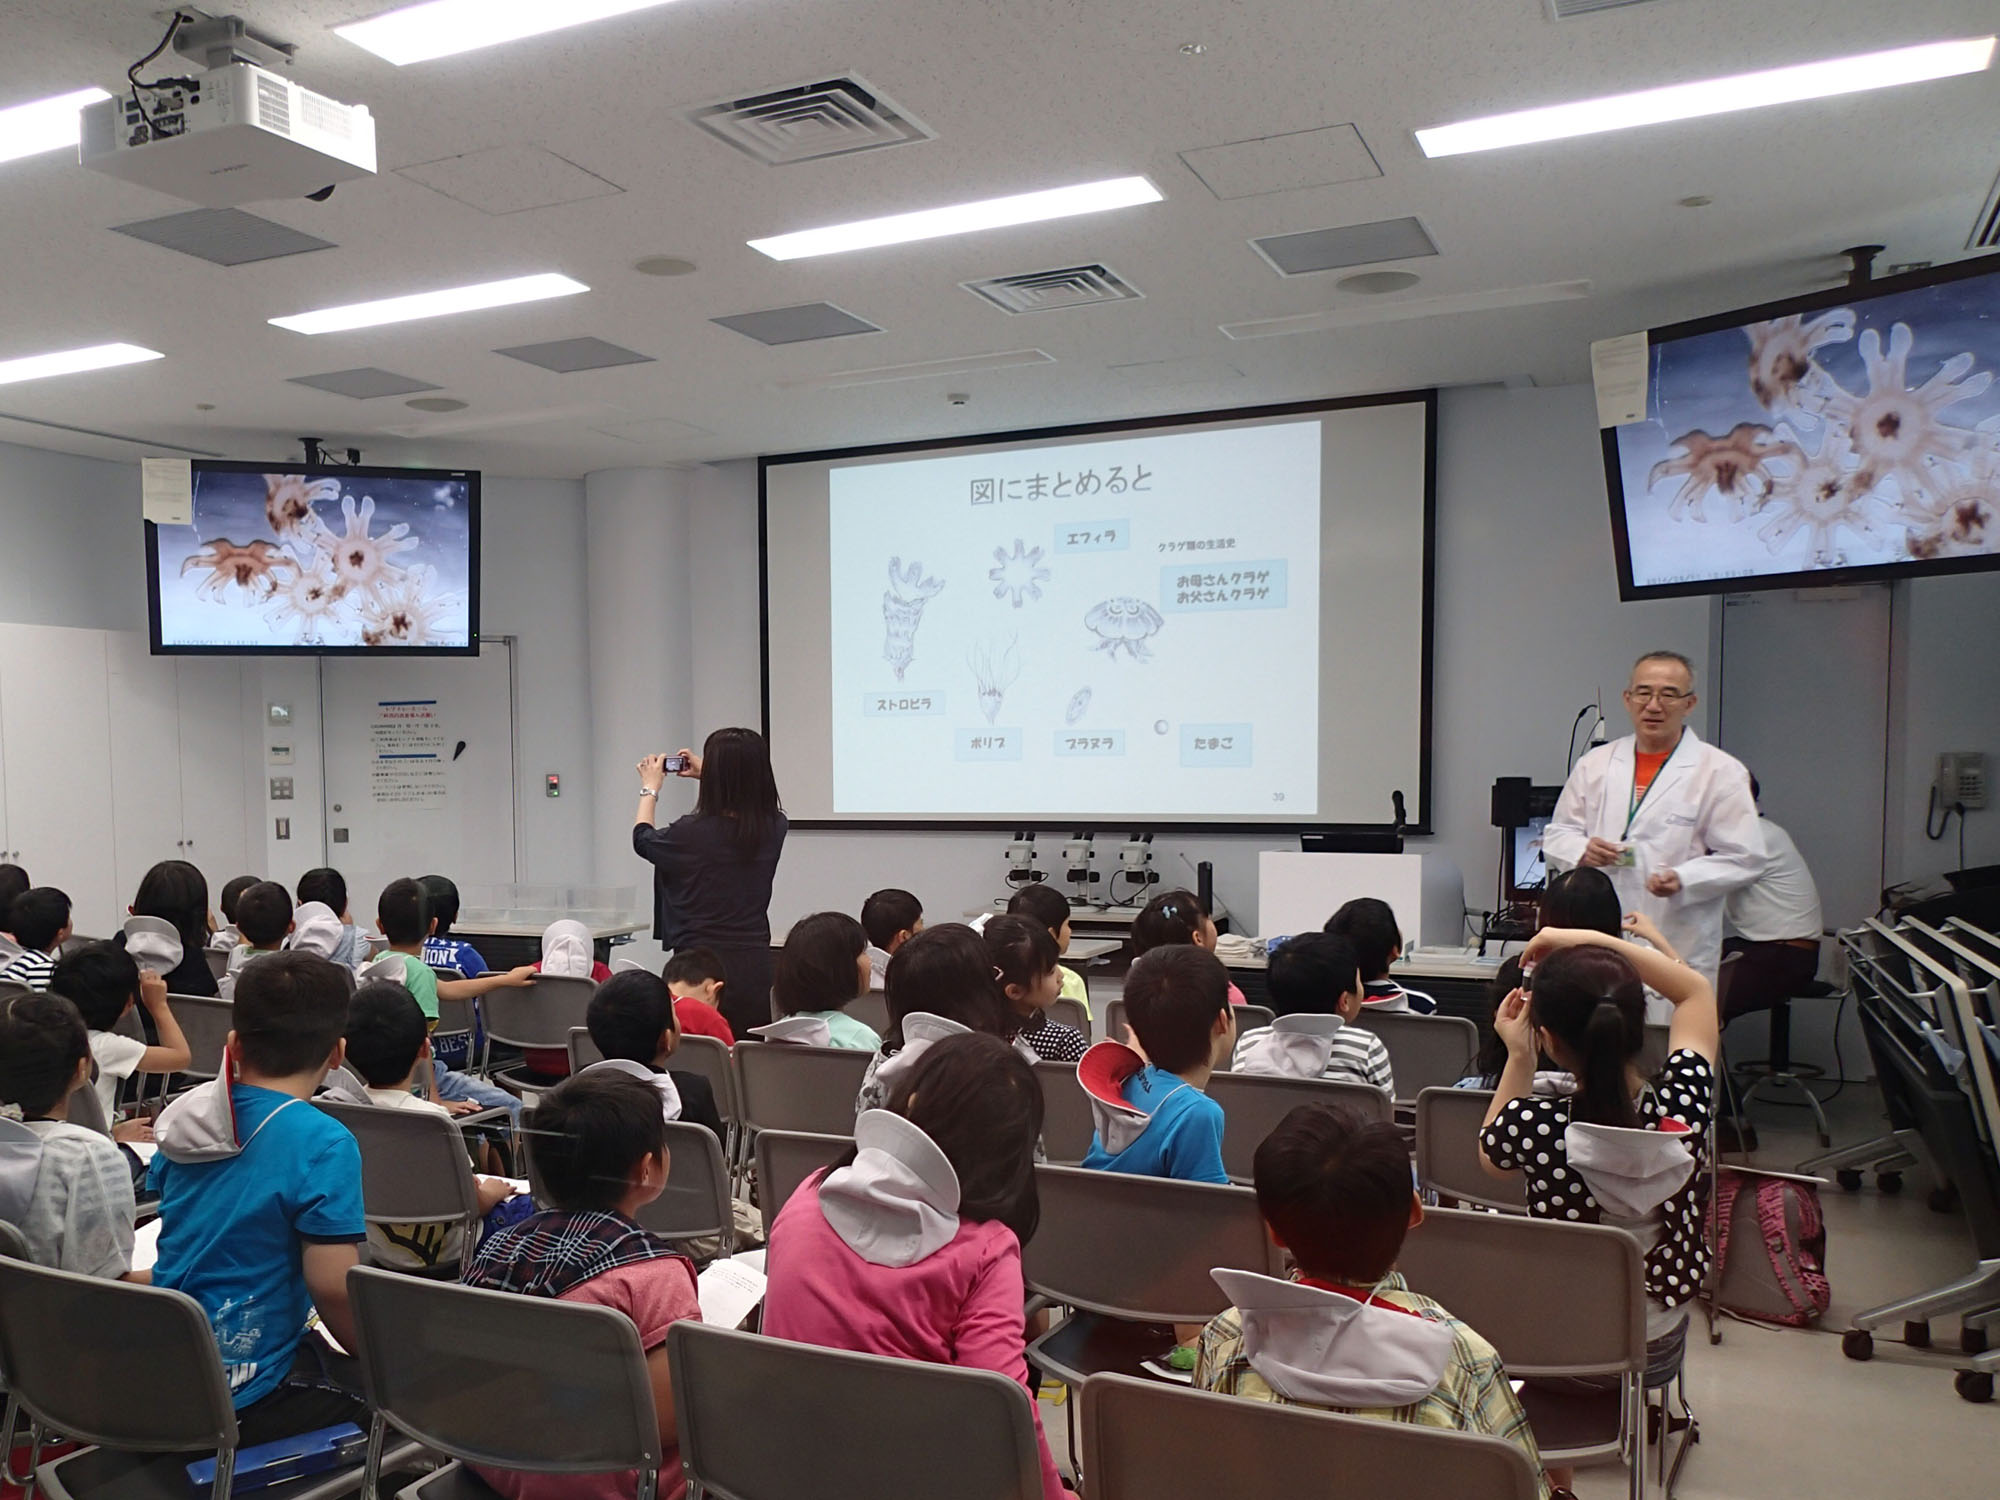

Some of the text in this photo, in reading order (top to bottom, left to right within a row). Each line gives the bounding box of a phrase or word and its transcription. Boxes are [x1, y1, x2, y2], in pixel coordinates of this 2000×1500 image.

[970, 463, 1152, 506] 図にまとめると
[1067, 529, 1117, 545] エフィラ
[1177, 570, 1270, 588] お母さんクラゲ
[1177, 587, 1270, 604] お父さんクラゲ
[1194, 737, 1233, 750] たまご
